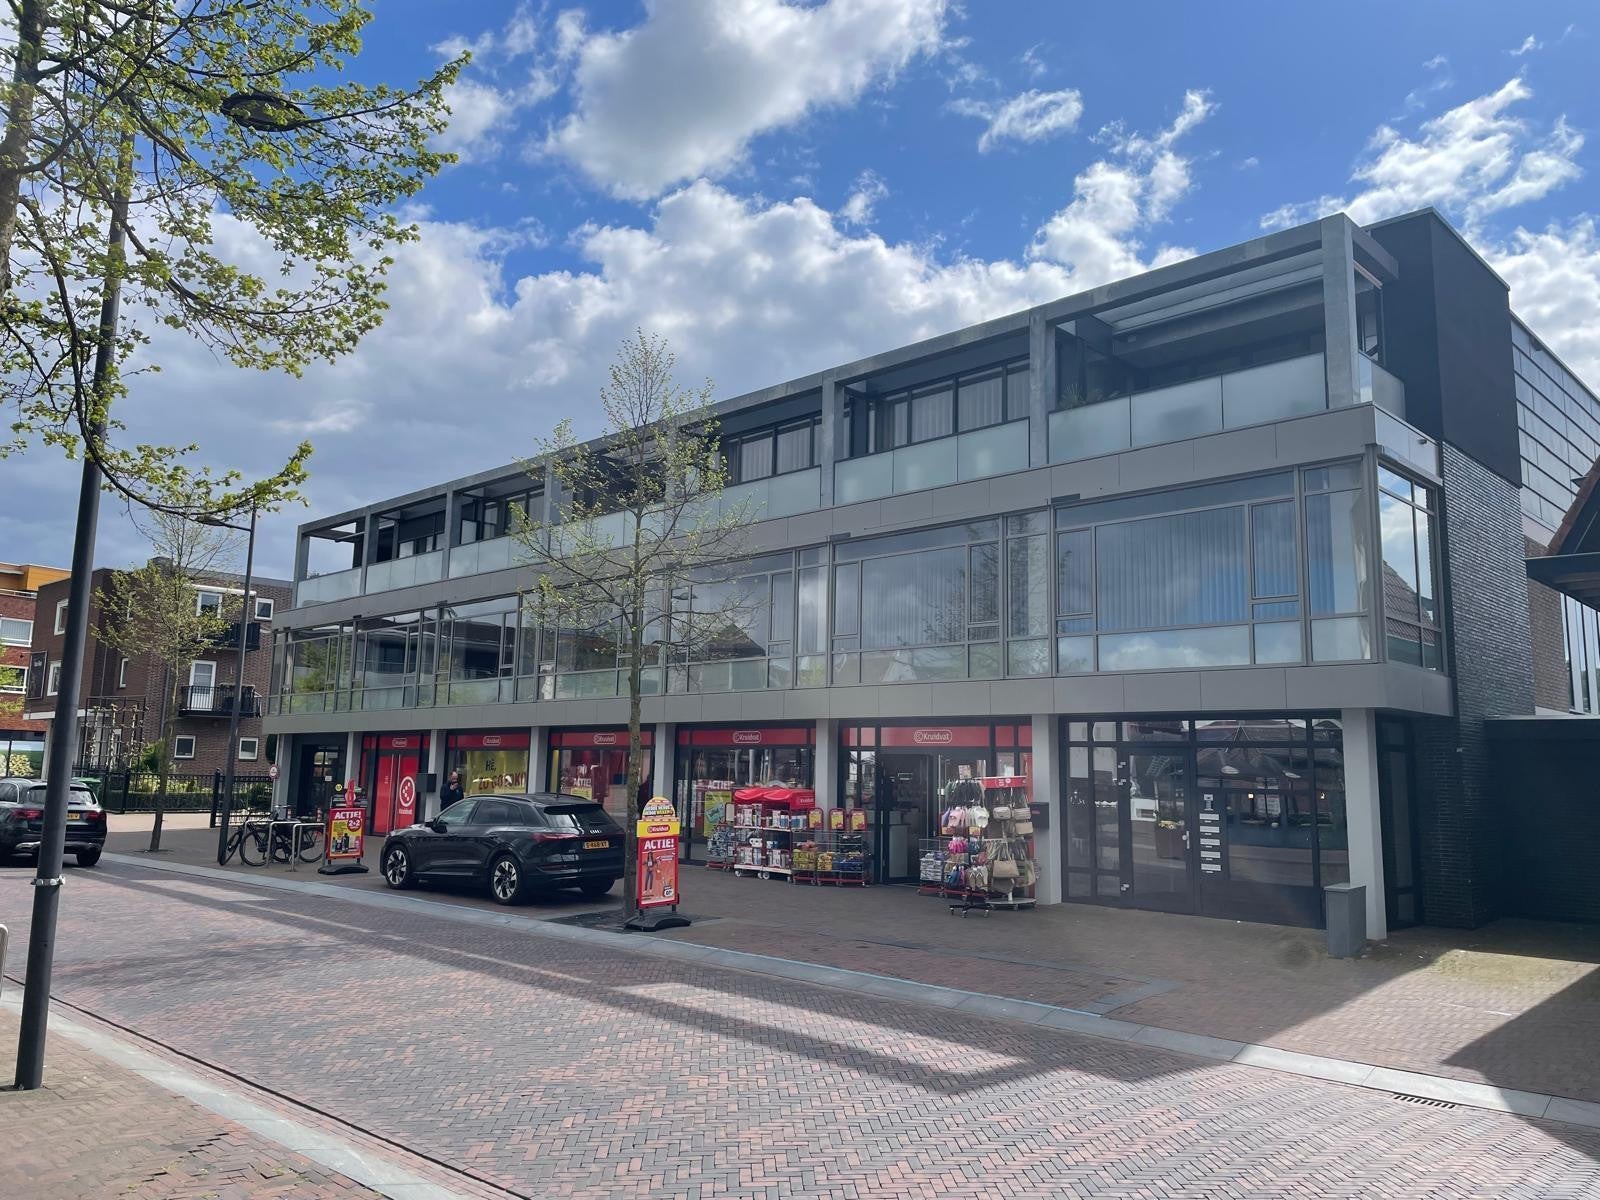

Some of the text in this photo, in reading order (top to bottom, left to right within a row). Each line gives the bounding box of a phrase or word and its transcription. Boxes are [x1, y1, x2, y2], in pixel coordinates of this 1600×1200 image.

[923, 732, 950, 741] Kruidvat
[334, 811, 362, 820] ACTIE!
[643, 838, 675, 851] ACTIE!
